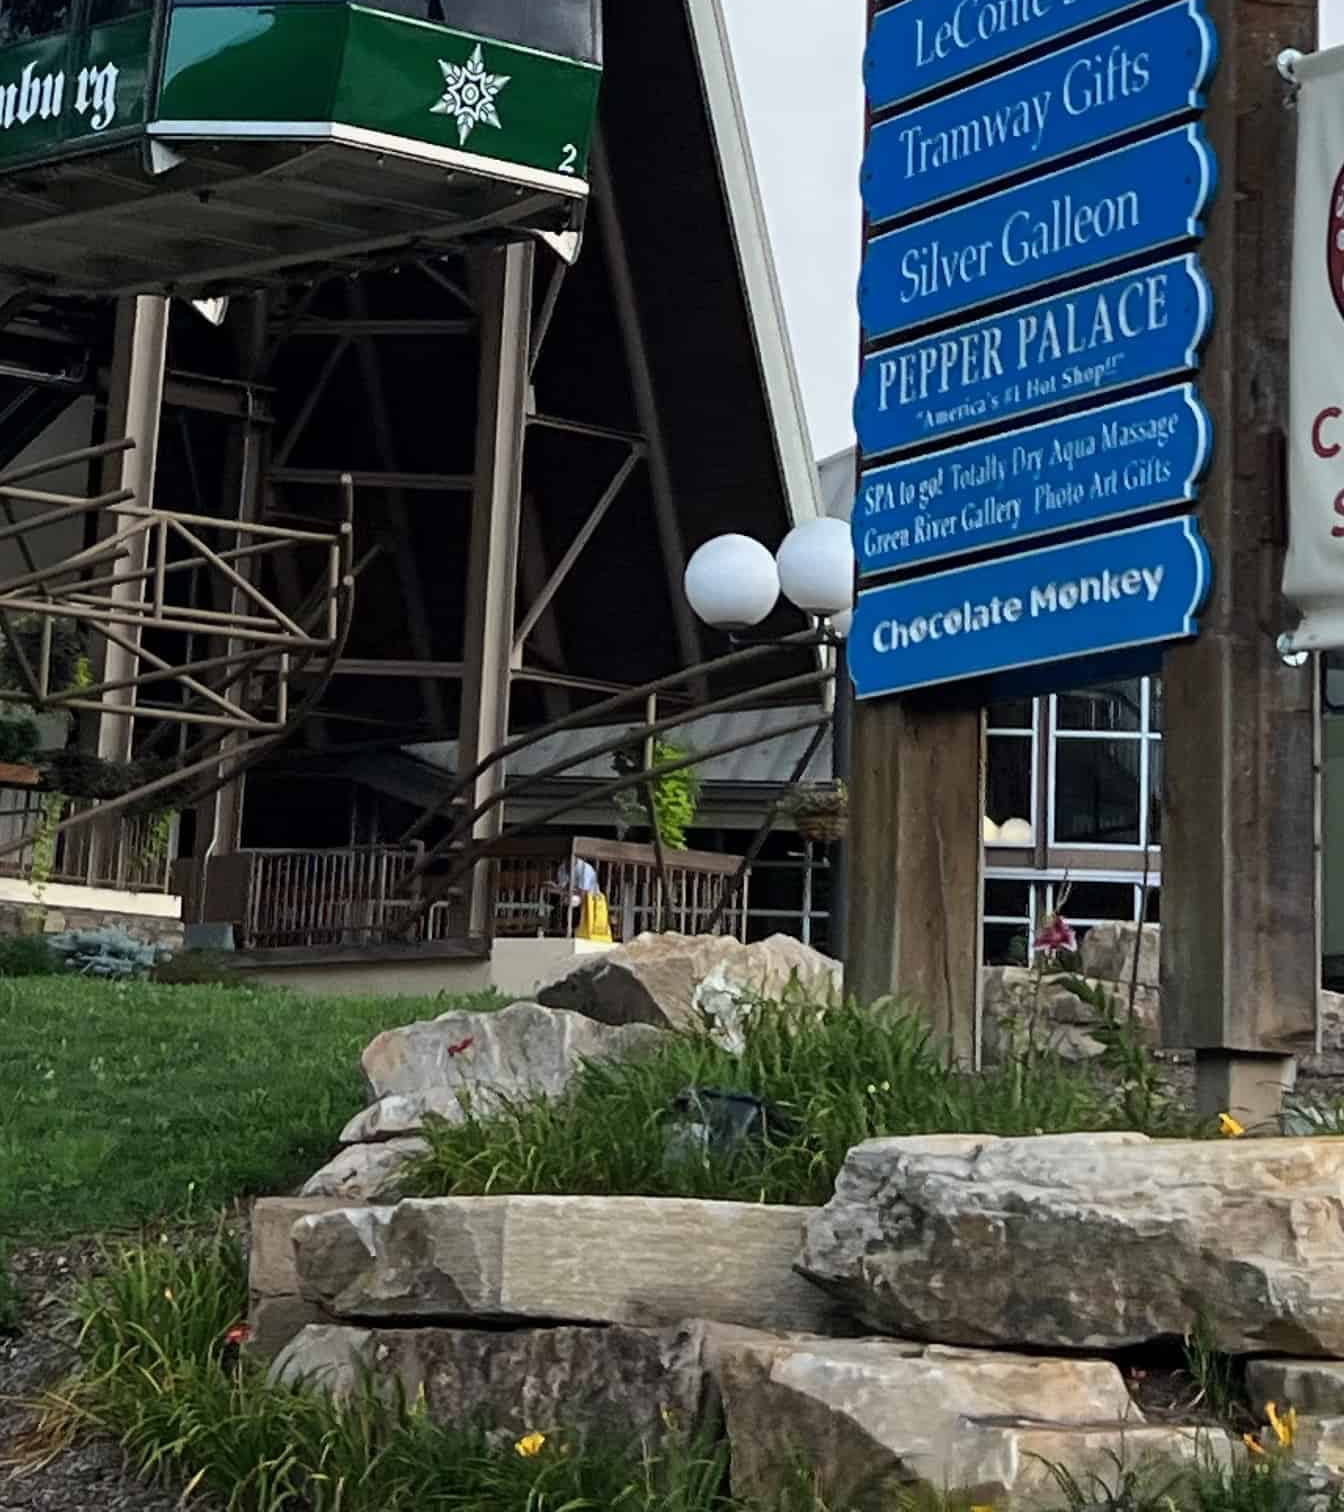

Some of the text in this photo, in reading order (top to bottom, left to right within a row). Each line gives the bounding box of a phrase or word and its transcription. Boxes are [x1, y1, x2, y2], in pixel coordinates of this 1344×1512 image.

[558, 143, 577, 173] 2
[899, 45, 1150, 179] Tramway Gifts
[900, 188, 1141, 304] Silver Galleon
[877, 273, 1170, 412] PEPPER PALACE
[864, 413, 1179, 516] SPA to go! Totally Dry Aqua Massage
[864, 456, 1171, 558] Green River Gallery Photo Art Gifts
[872, 564, 1165, 653] Chocolate Monkey
